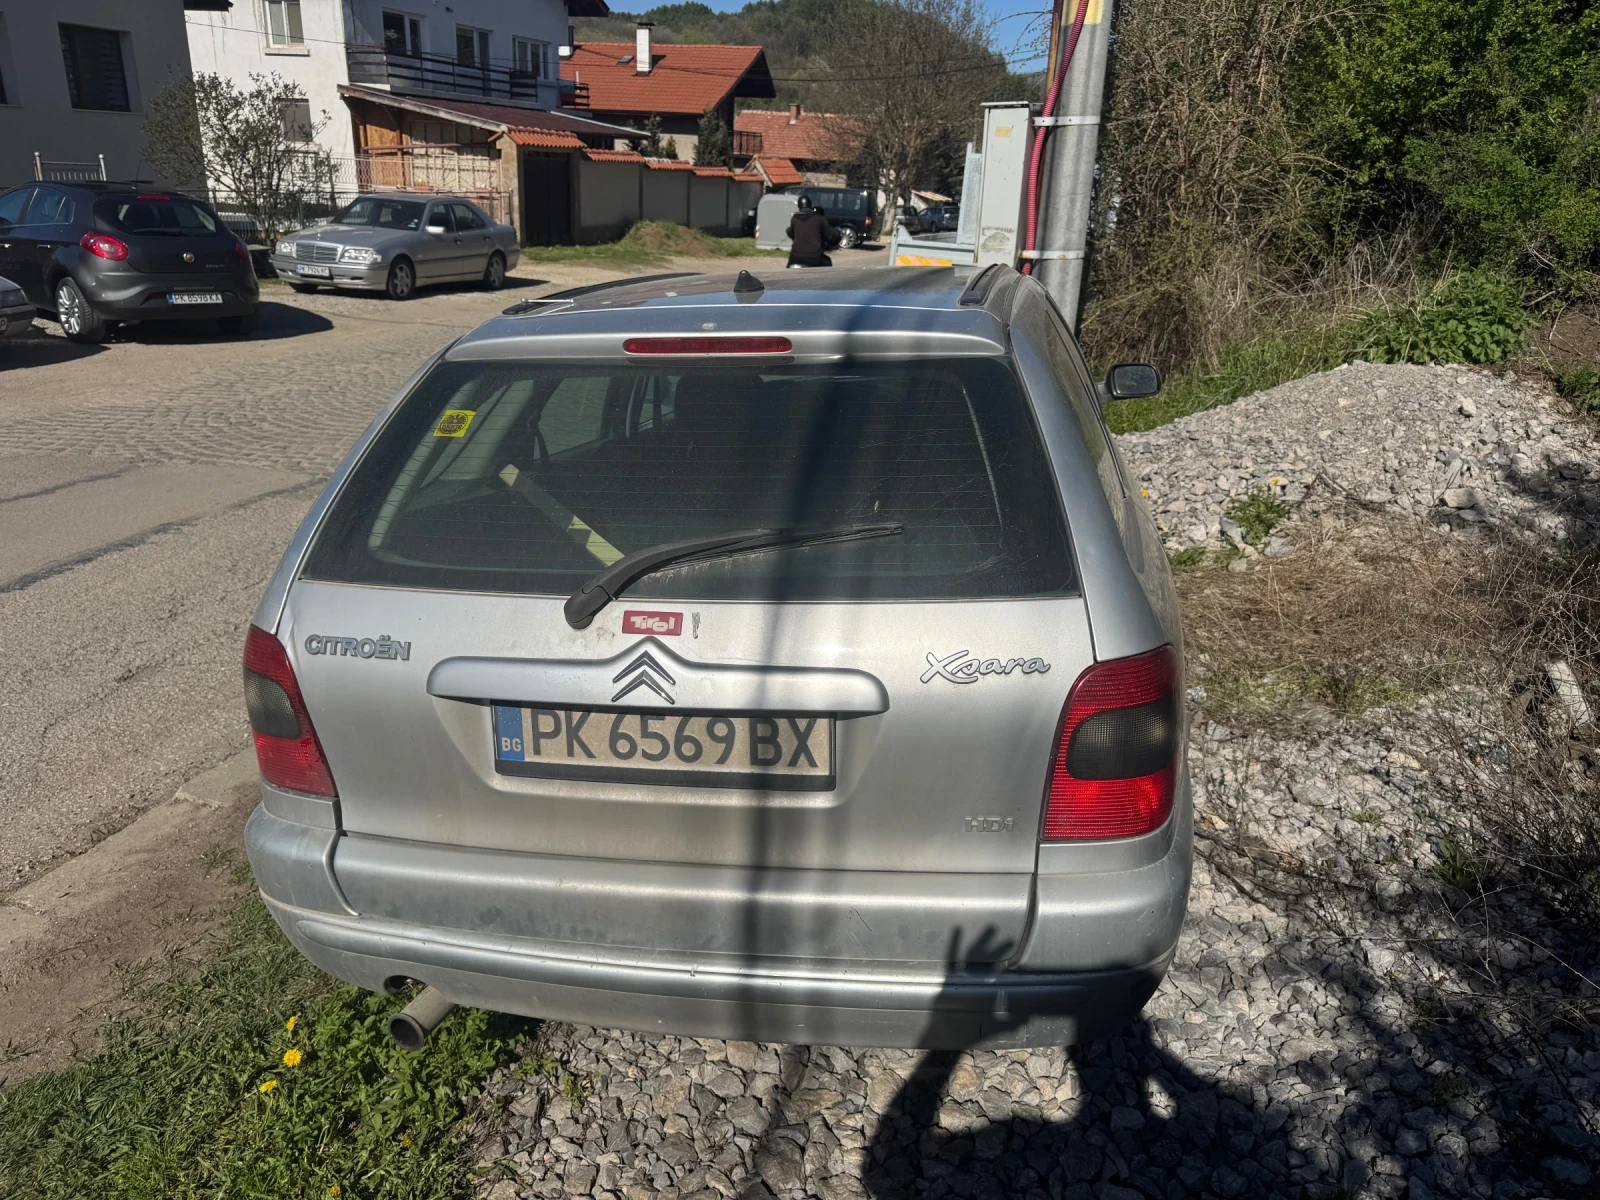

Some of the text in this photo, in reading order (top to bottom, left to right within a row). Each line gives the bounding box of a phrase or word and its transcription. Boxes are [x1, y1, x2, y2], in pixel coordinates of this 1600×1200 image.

[174, 293, 186, 302] PK
[630, 615, 675, 632] Tirol
[304, 634, 411, 661] CITROËN
[920, 649, 1051, 684] Xsara
[501, 737, 522, 752] BG
[530, 708, 819, 768] PK 6569 BX
